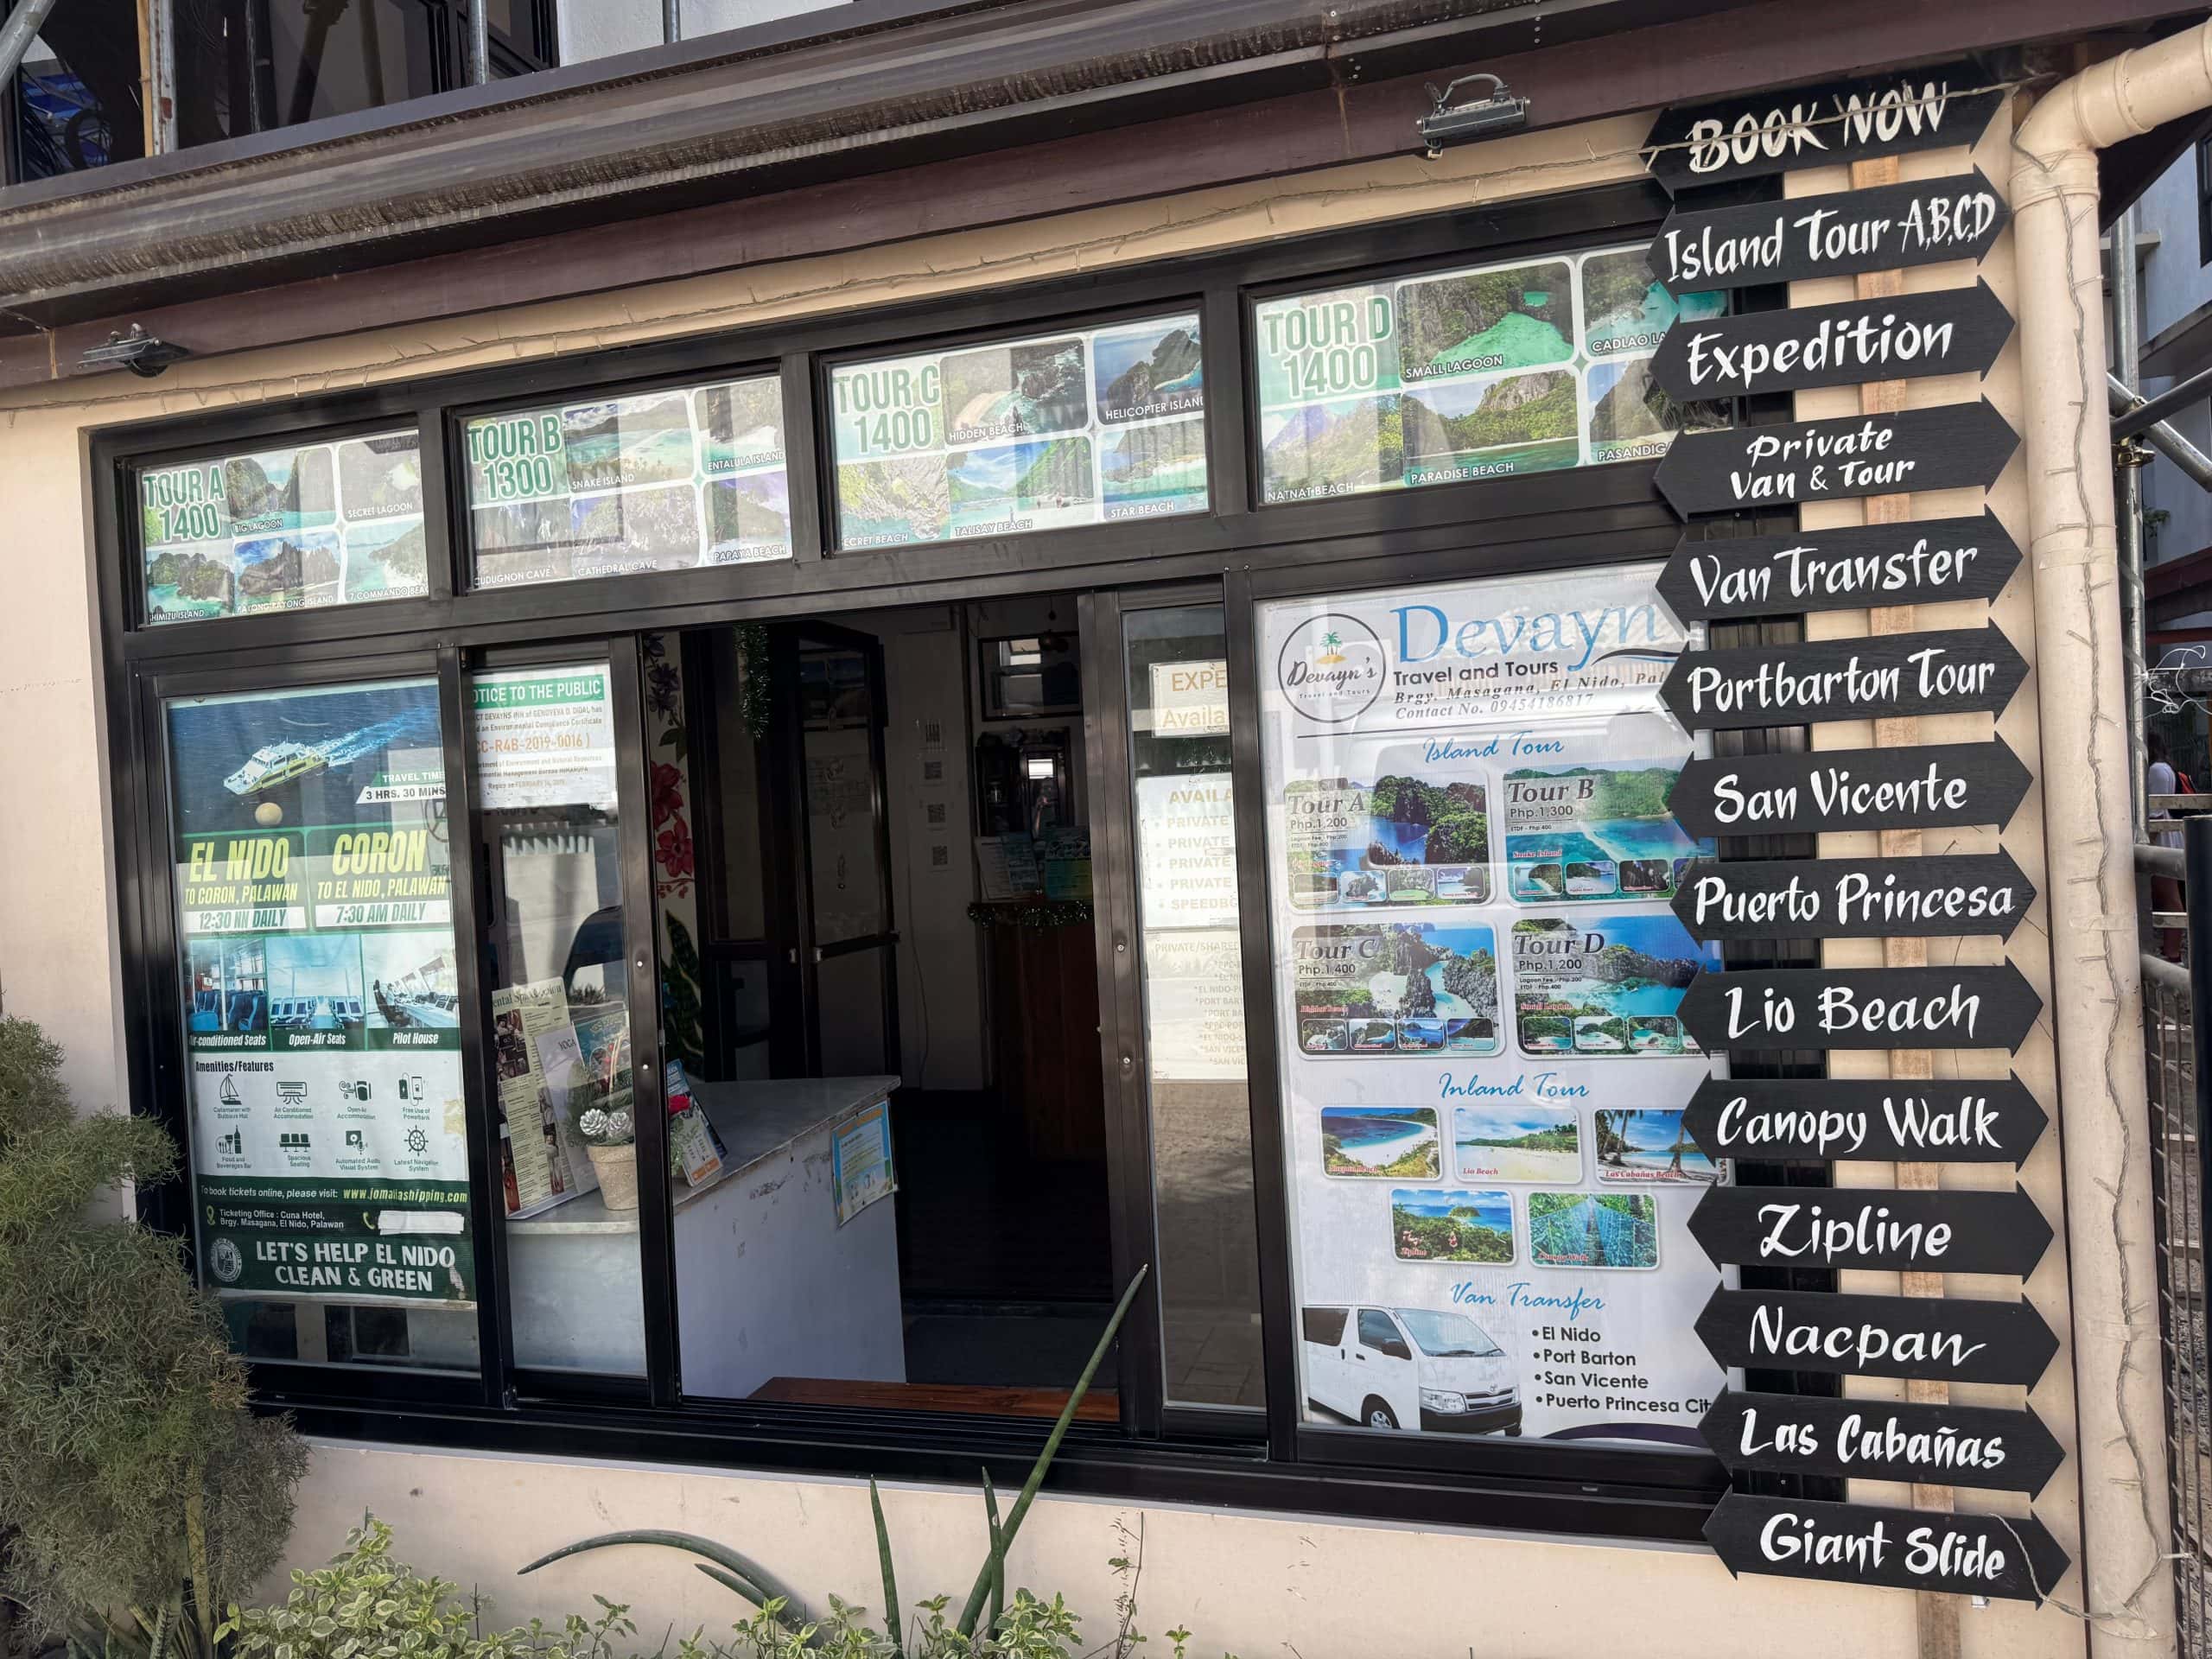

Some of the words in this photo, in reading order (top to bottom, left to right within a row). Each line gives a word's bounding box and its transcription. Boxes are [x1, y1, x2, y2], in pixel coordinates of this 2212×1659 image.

[1685, 102, 1829, 174] BOOK
[1833, 81, 1948, 147] NOW
[1664, 217, 1783, 283] Island
[1793, 208, 1891, 262] Tour
[1262, 302, 1355, 355] TOUR
[1369, 297, 1391, 342] D
[1592, 335, 1649, 352] CADLAO
[1687, 313, 1954, 389] Expedition
[1284, 347, 1376, 397] 1400
[1406, 365, 1443, 379] SMALL
[1446, 355, 1503, 374] LAGOON
[834, 369, 915, 414] TOUR
[918, 365, 940, 404] C
[1105, 403, 1167, 421] HELICOPTER
[469, 421, 535, 462] TOUR
[543, 414, 561, 452] B
[854, 410, 931, 453] 1400
[950, 427, 987, 441] HIDDEN
[989, 423, 1024, 436] BEACH
[1746, 421, 1893, 467] Private
[483, 455, 551, 499] 1300
[572, 479, 601, 490] SNAKE
[603, 474, 634, 486] ISLAND
[1411, 467, 1468, 485] PARADISE
[1472, 462, 1514, 478] BEACH
[1730, 471, 1795, 500] Van
[1810, 464, 1829, 491] &
[1838, 459, 1915, 487] Tour
[143, 470, 202, 508] TOUR
[209, 466, 225, 500] A
[1315, 482, 1355, 498] BEACH
[347, 507, 375, 518] SECRET
[377, 502, 414, 515] LAGOON
[1111, 505, 1135, 518] STAR
[1139, 501, 1175, 514] BEACH
[160, 504, 219, 542] 1400
[234, 524, 248, 534] BIG
[249, 519, 283, 531] LAGOON
[955, 522, 995, 536] TALISAY
[997, 518, 1033, 532] BEACH
[842, 536, 873, 547] ECRET
[877, 532, 908, 545] BEACH
[578, 563, 630, 576] CATHEDRAL
[632, 560, 658, 571] CAVE
[1689, 555, 1771, 606] Van
[1773, 538, 1977, 597] Transfer
[306, 595, 334, 605] ISLAND
[349, 592, 355, 601] 7
[357, 587, 408, 600] COMMANDO
[179, 609, 205, 620] ISLAND
[1389, 603, 1656, 672] Devayn
[1287, 657, 1377, 690] Devayn's
[1394, 667, 1452, 686] Travel
[1459, 663, 1498, 681] and
[1505, 660, 1558, 677] Tours
[1687, 656, 1900, 714] Portbarton
[1907, 647, 1994, 698] Tour
[510, 686, 525, 701] TO
[529, 683, 553, 699] THE
[557, 680, 601, 698] PUBLIC
[1395, 706, 1452, 719] Contact
[1459, 703, 1484, 716] No.
[1423, 734, 1499, 763] Island
[1512, 730, 1565, 755] Tour
[383, 772, 421, 784] TRAVEL
[366, 791, 372, 800] 3
[375, 789, 400, 799] HRS.
[403, 787, 416, 798] 30
[1509, 782, 1569, 803] Tour
[1576, 779, 1594, 800] B
[1713, 773, 1797, 823] San
[1810, 762, 1967, 816] Vicente
[1288, 796, 1343, 815] Tour
[1348, 792, 1364, 812] A
[1167, 816, 1230, 829] PRIVATE
[333, 830, 428, 876] CORON
[1168, 836, 1230, 849] PRIVATE
[189, 842, 217, 883] EL
[226, 837, 289, 881] NIDO
[185, 889, 195, 904] TO
[198, 886, 238, 905] CORON,
[242, 883, 298, 902] PALAWAN
[318, 882, 332, 899] TO
[335, 881, 347, 899] EL
[387, 877, 448, 896] PALAWAN
[1694, 875, 1820, 925] Puerto
[1835, 873, 2016, 925] Princesa
[200, 912, 232, 931] 12:30
[251, 909, 287, 928] DAILY
[336, 905, 365, 925] 7:30
[366, 904, 388, 924] AM
[390, 903, 426, 922] DAILY
[1296, 940, 1351, 960] Tour
[1358, 938, 1376, 959] C
[1515, 935, 1576, 955] Tour
[1584, 933, 1605, 954] D
[1519, 959, 1582, 972] Php.1,200
[1725, 986, 1795, 1039] Lio
[1818, 983, 1980, 1039] Beach
[244, 1034, 266, 1046] Seats
[392, 1033, 411, 1044] Pilot
[413, 1032, 439, 1044] House
[195, 1061, 274, 1072] Amenities/Features
[1438, 1072, 1525, 1099] Inland
[1534, 1072, 1590, 1098] Tour
[1716, 1096, 1866, 1155] Canopy
[1883, 1096, 2003, 1149] Walk
[209, 1186, 226, 1196] book
[229, 1187, 257, 1197] tickets
[258, 1188, 284, 1198] online,
[287, 1189, 317, 1201] please
[219, 1210, 252, 1219] Ticketing
[1758, 1203, 1952, 1263] Zipline
[256, 1241, 308, 1262] LET'S
[314, 1243, 369, 1263] HELP
[376, 1243, 397, 1264] EL
[402, 1245, 455, 1268] NIDO
[275, 1265, 341, 1286] CLEAN
[348, 1267, 361, 1287] &
[367, 1268, 433, 1292] GREEN
[1452, 1282, 1497, 1306] Van
[1507, 1281, 1606, 1320] Transfer
[1542, 1326, 1554, 1340] El
[1561, 1327, 1600, 1342] Nido
[1749, 1305, 1986, 1369] Nacpan
[1544, 1349, 1575, 1363] Port
[1581, 1351, 1637, 1366] Barton
[1545, 1371, 1575, 1386] San
[1581, 1373, 1649, 1389] Vicente
[1547, 1394, 1599, 1409] Puerto
[1605, 1396, 1680, 1413] Princesa
[1685, 1398, 1712, 1414] Cit
[1740, 1408, 1818, 1457] Las
[1836, 1414, 2005, 1469] Cabañas
[1760, 1512, 1893, 1573] Giant
[1904, 1527, 2005, 1580] Slide
